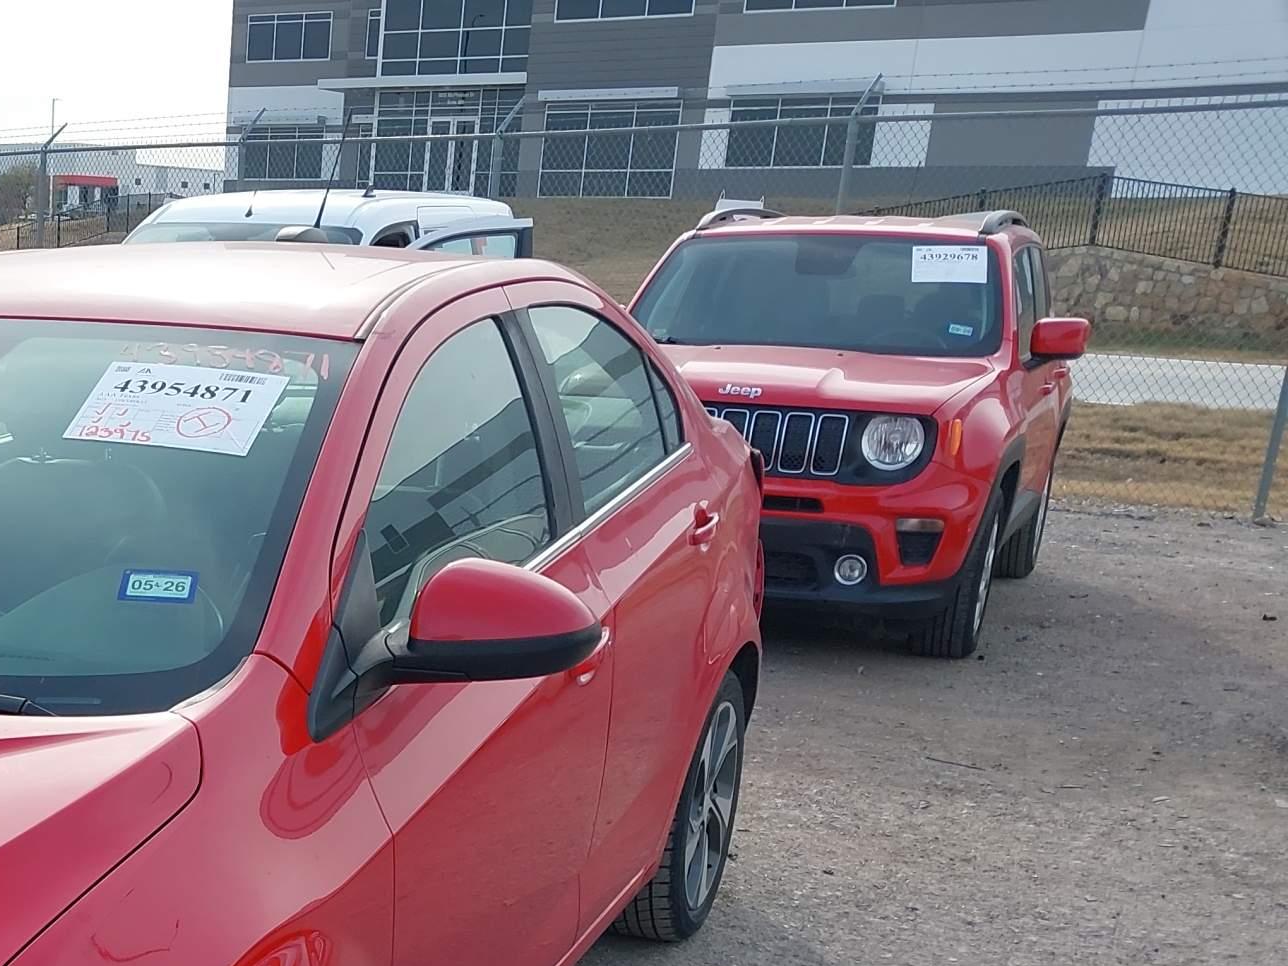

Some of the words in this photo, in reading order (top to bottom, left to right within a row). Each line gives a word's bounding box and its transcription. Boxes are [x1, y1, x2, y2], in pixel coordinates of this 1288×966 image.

[920, 253, 979, 261] 43929678
[112, 379, 253, 404] 43954871
[718, 383, 763, 398] Jeep
